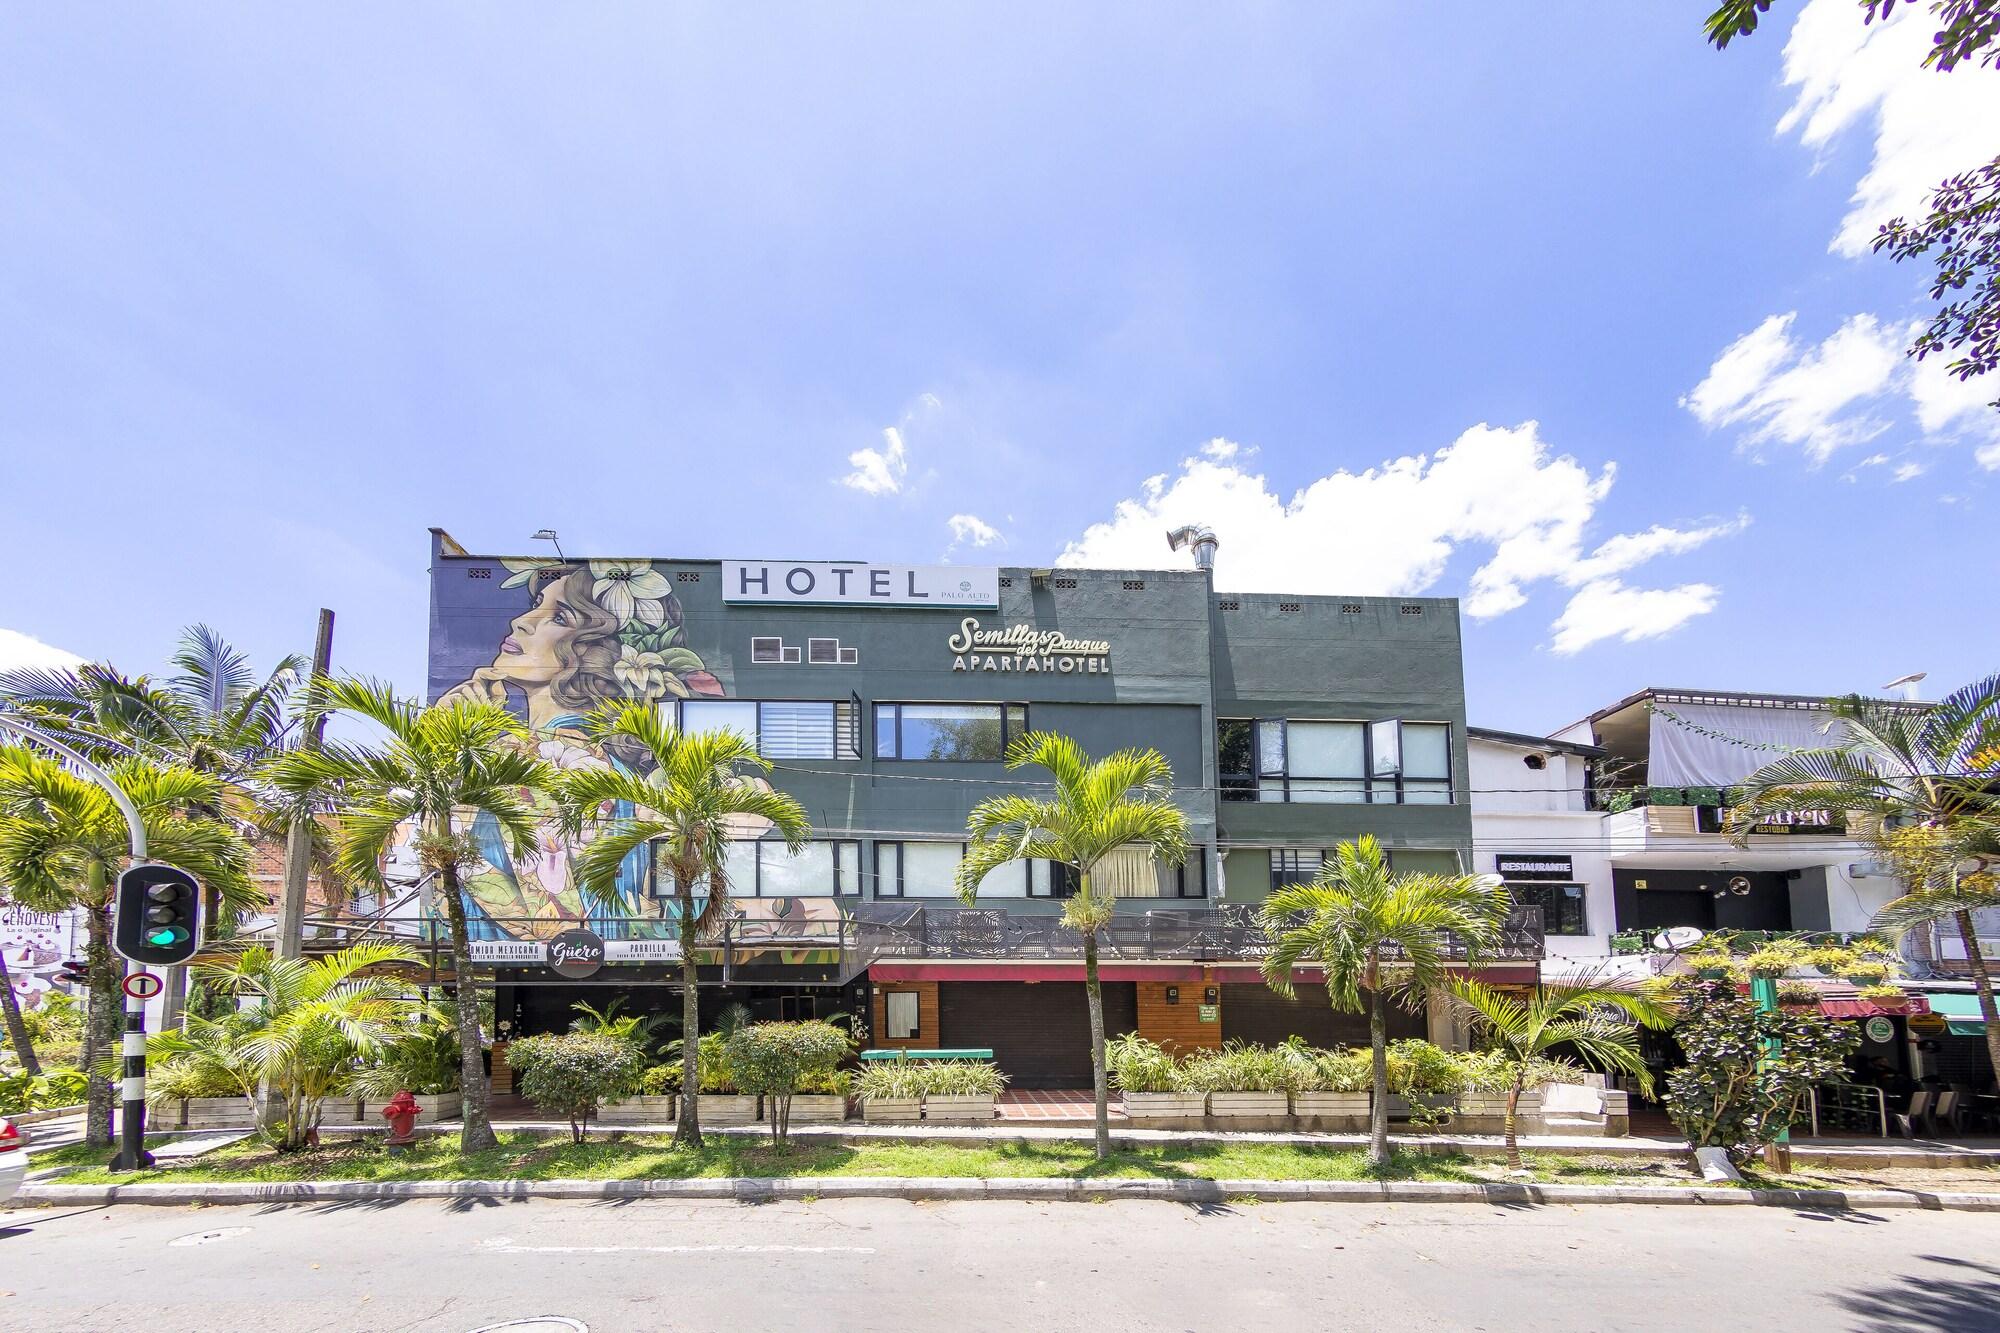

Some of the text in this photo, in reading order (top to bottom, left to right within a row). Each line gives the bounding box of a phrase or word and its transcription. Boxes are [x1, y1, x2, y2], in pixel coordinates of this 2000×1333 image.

[740, 567, 929, 598] HOTEL
[948, 617, 1110, 656] Semillas del Parque
[952, 655, 1109, 673] APARTAHOTEL
[1500, 862, 1572, 872] RESTAURANTE
[470, 945, 540, 955] OMIDA MEXICANA
[551, 941, 602, 967] Güero
[630, 944, 666, 953] PARRILLA
